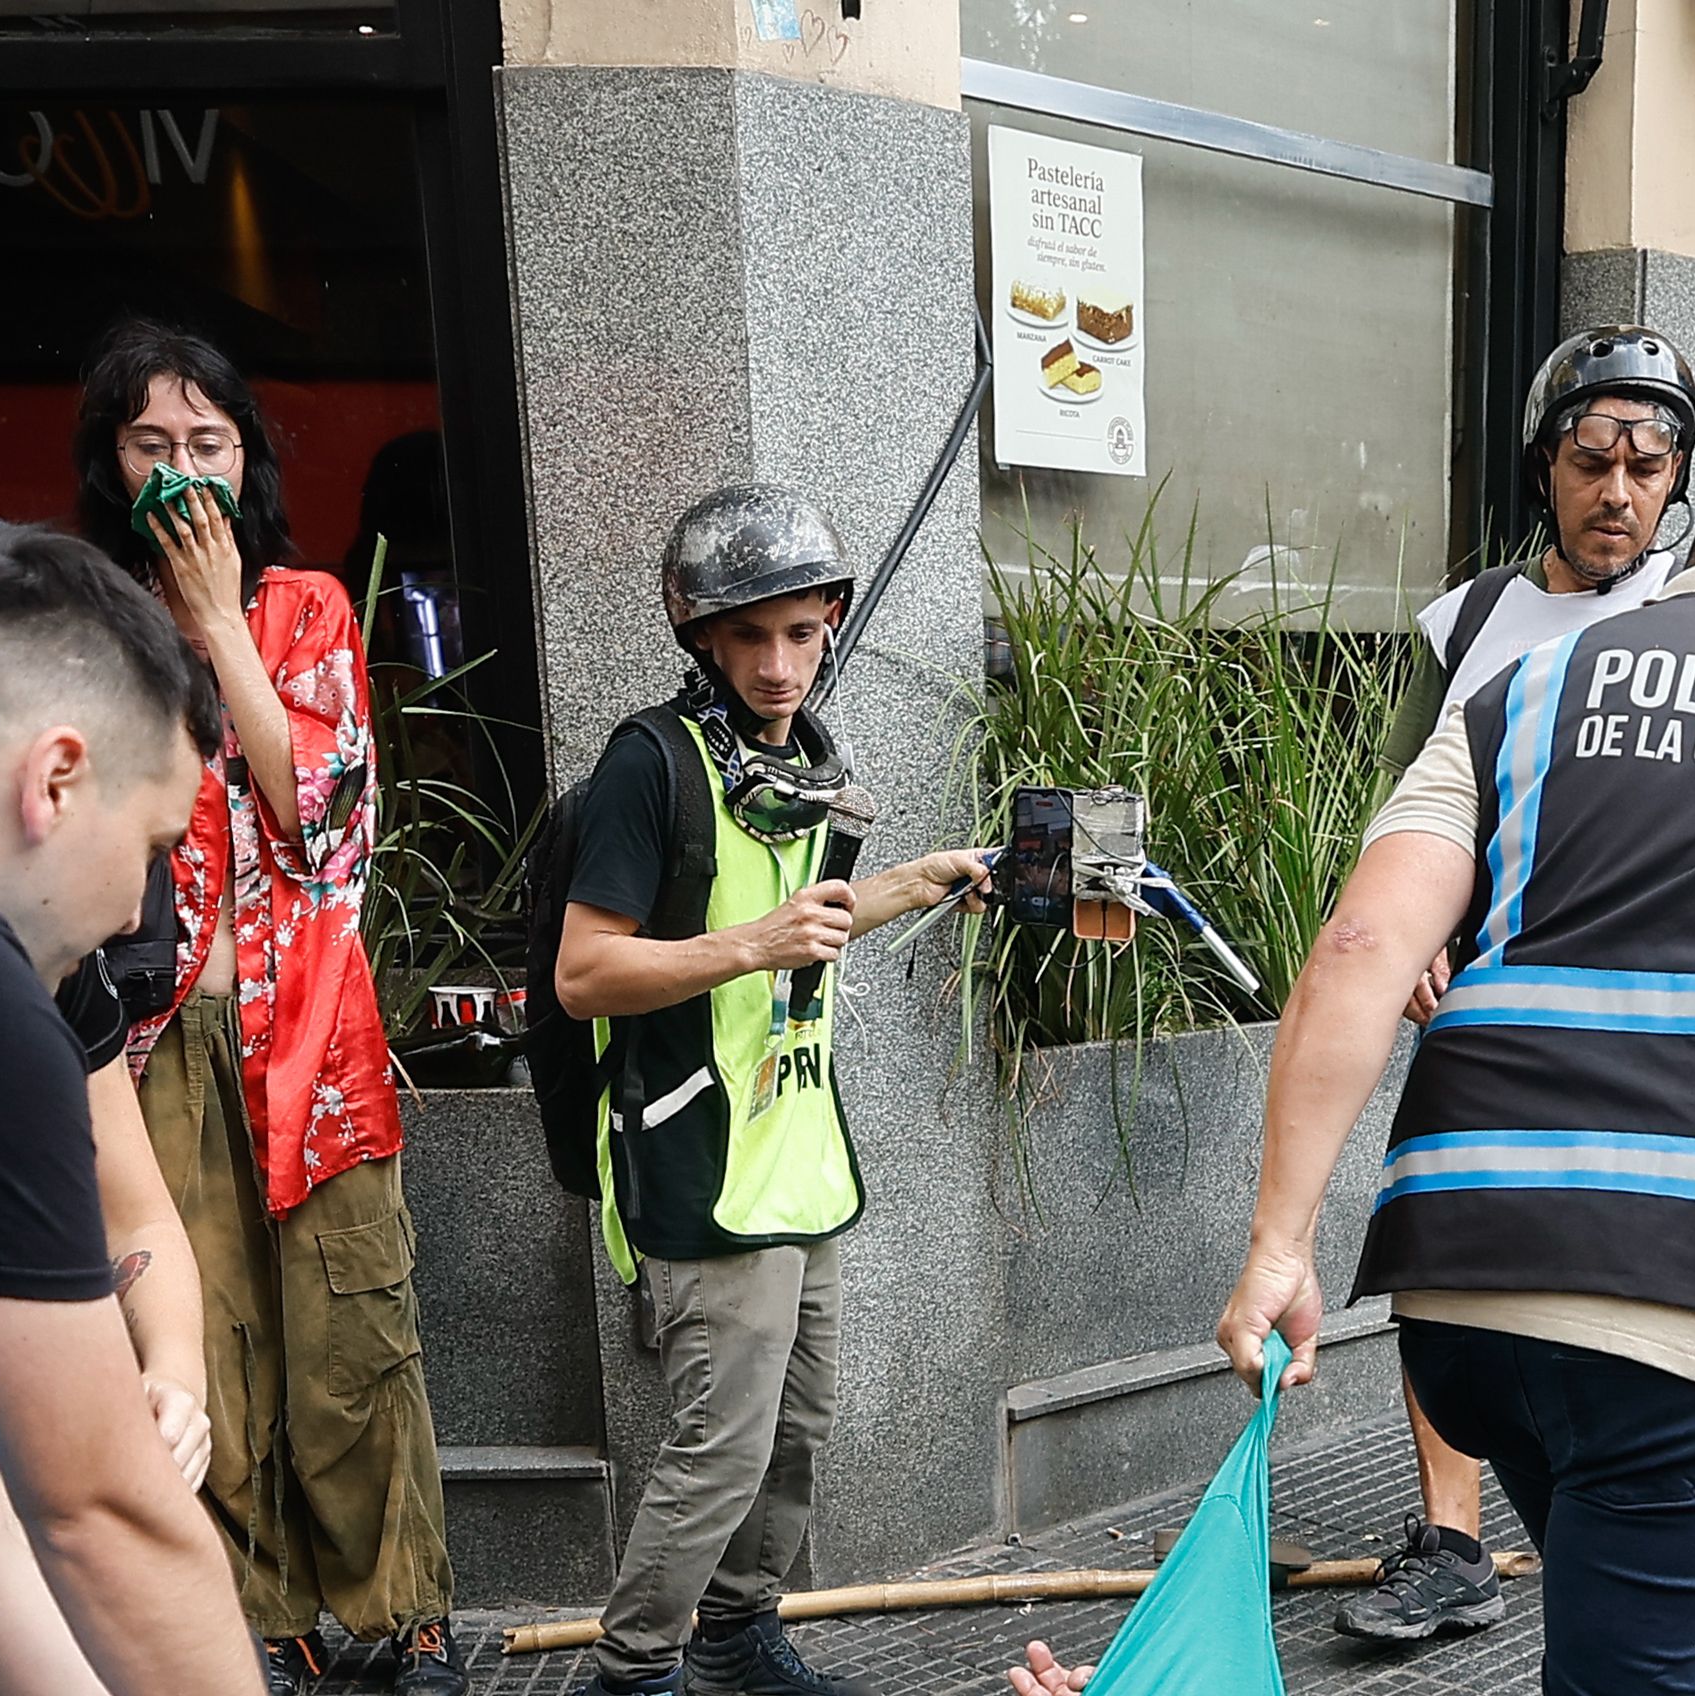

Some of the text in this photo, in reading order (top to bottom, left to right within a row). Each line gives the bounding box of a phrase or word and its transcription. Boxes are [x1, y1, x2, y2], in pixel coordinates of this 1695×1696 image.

[1028, 158, 1104, 192] Pastelería
[1031, 188, 1102, 215] artesanal
[1032, 208, 1102, 239] sin TACC
[1575, 714, 1629, 759] DE
[1634, 715, 1683, 764] LA
